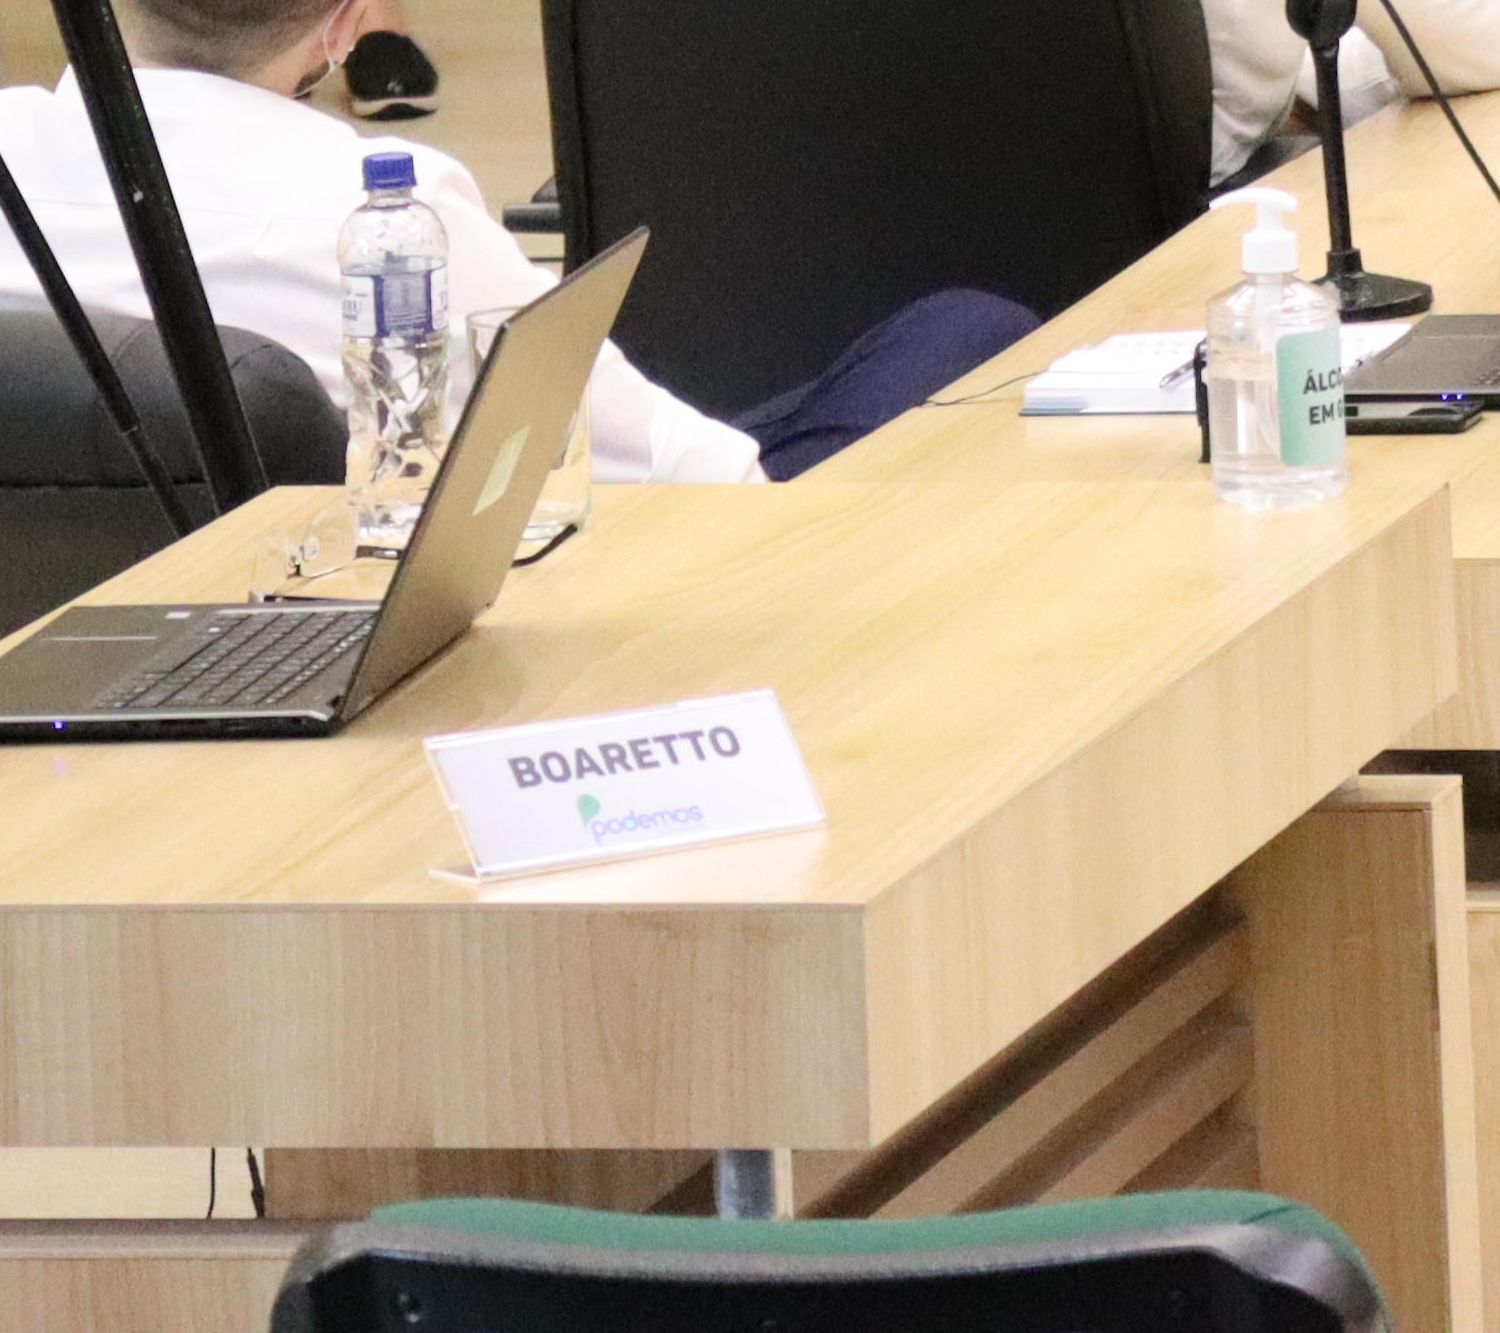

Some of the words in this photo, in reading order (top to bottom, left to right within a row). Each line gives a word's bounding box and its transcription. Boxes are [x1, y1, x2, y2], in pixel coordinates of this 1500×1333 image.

[1309, 403, 1335, 426] EM
[507, 726, 741, 789] BOARETTO
[590, 804, 705, 845] podemos
